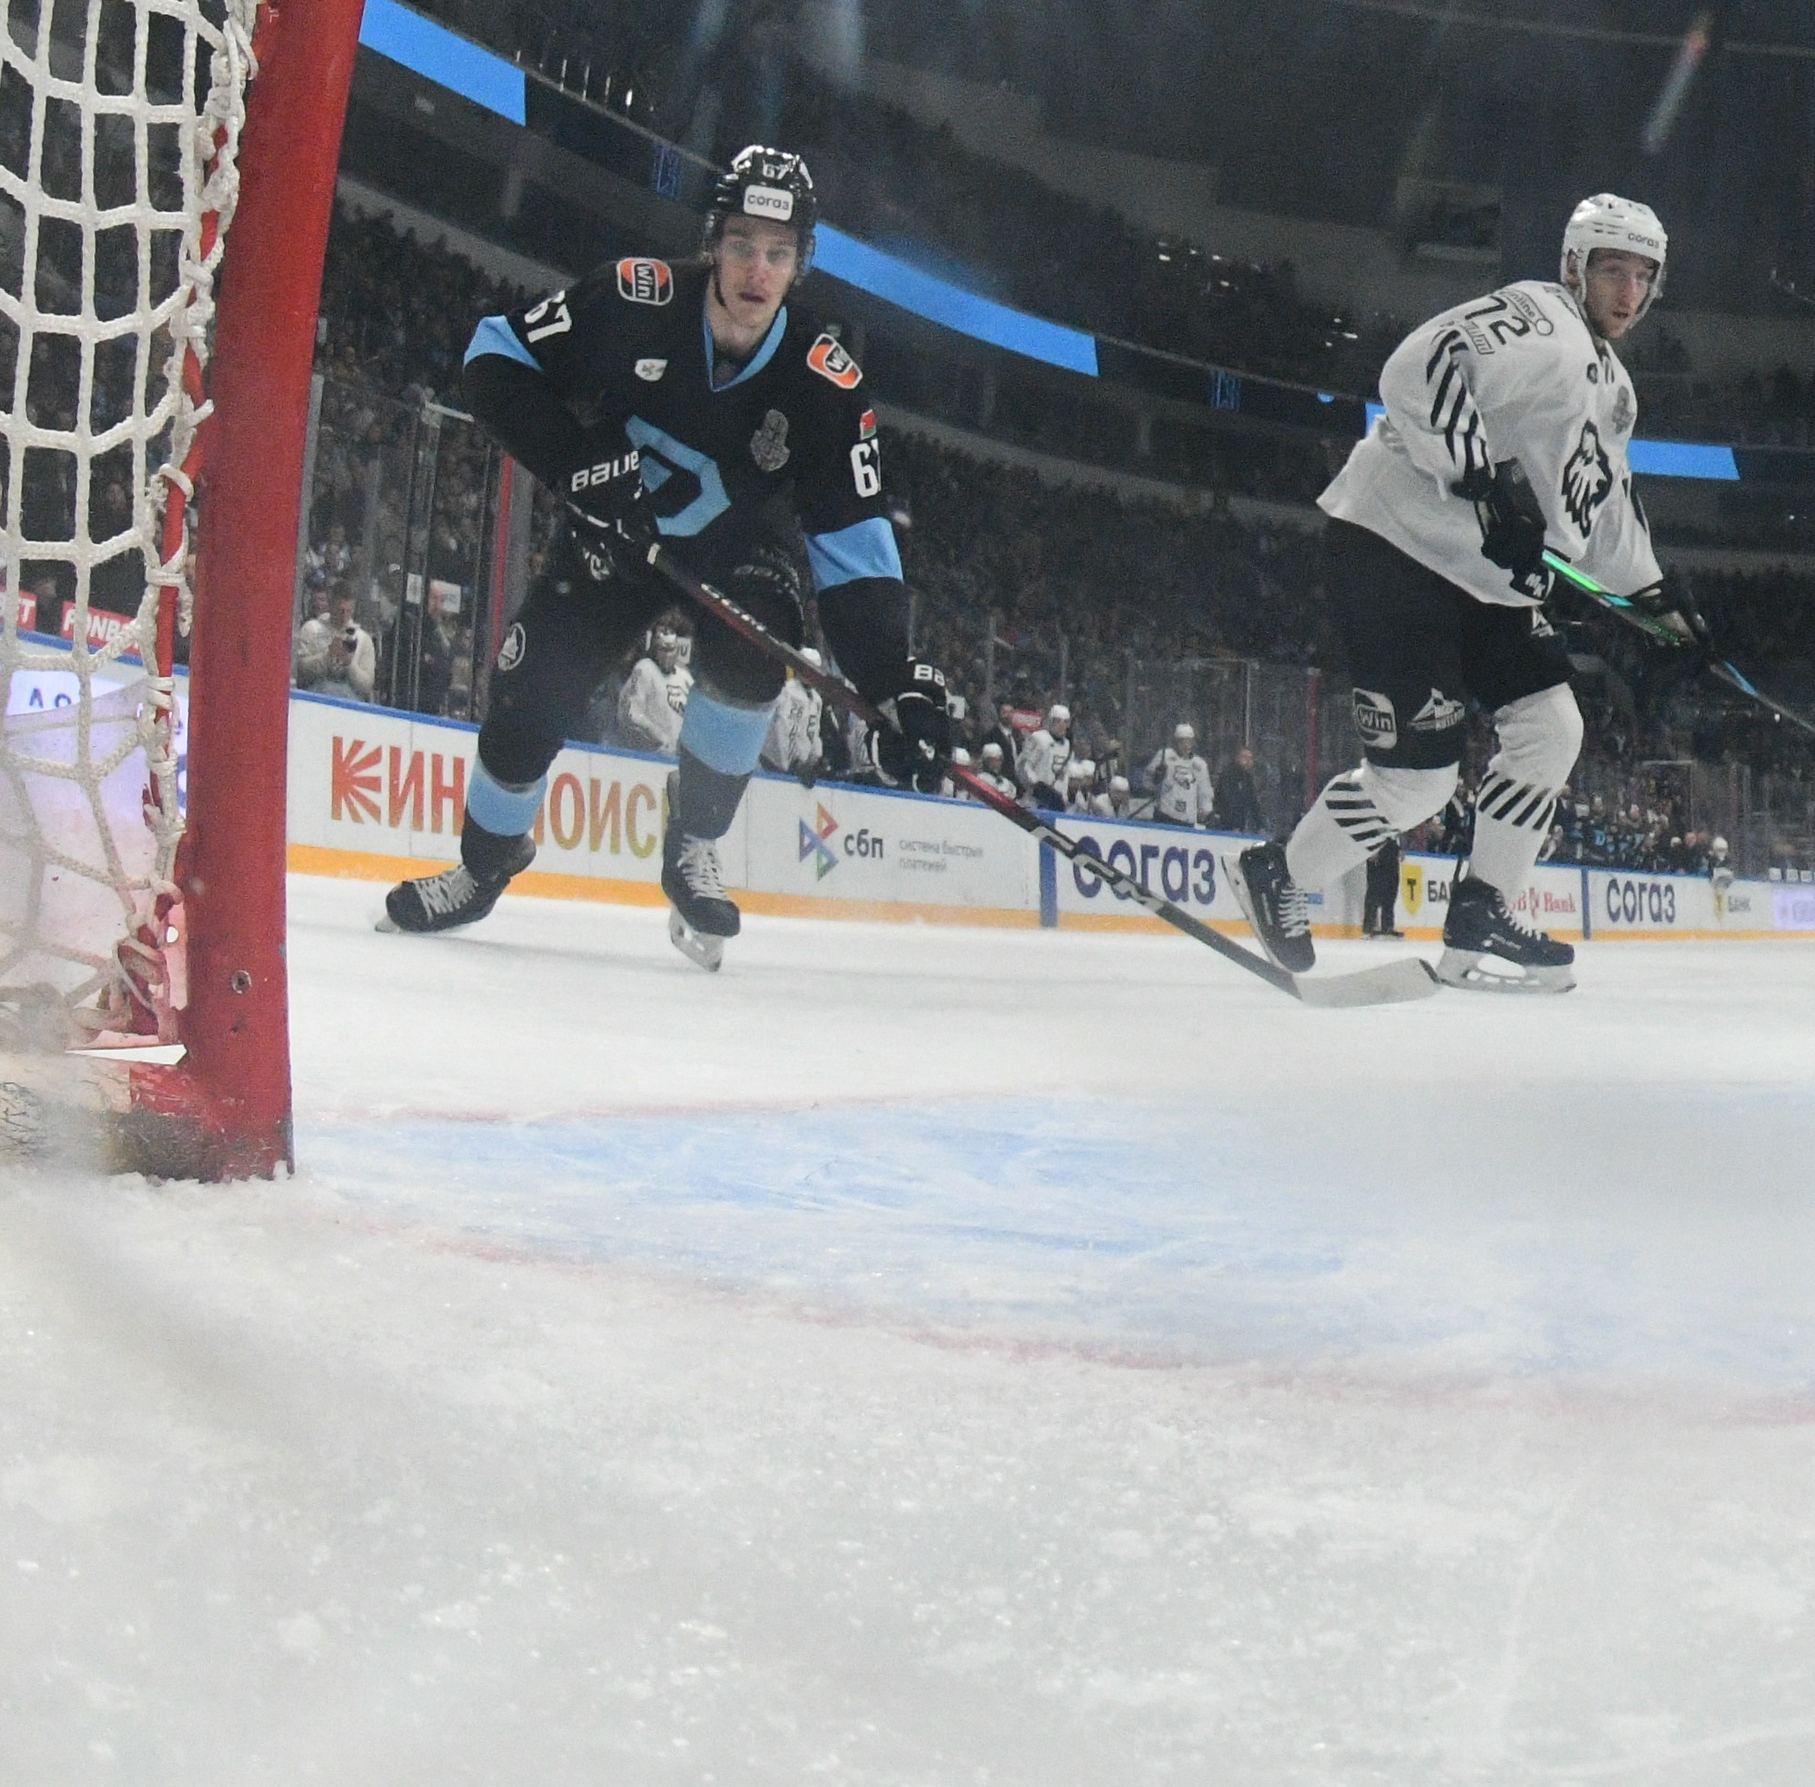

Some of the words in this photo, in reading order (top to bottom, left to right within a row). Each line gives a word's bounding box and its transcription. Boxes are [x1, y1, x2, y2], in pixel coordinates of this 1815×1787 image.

[762, 159, 790, 181] 67
[747, 194, 790, 211] согаз
[524, 290, 573, 343] 67
[1464, 295, 1530, 345] 72
[572, 449, 640, 492] BAUE
[1358, 710, 1393, 733] Win
[331, 736, 669, 859] КИНОИС
[844, 828, 885, 860] сбп
[1072, 835, 1217, 905] согаз
[1427, 879, 1452, 903] БА
[1606, 877, 1676, 924] согаз
